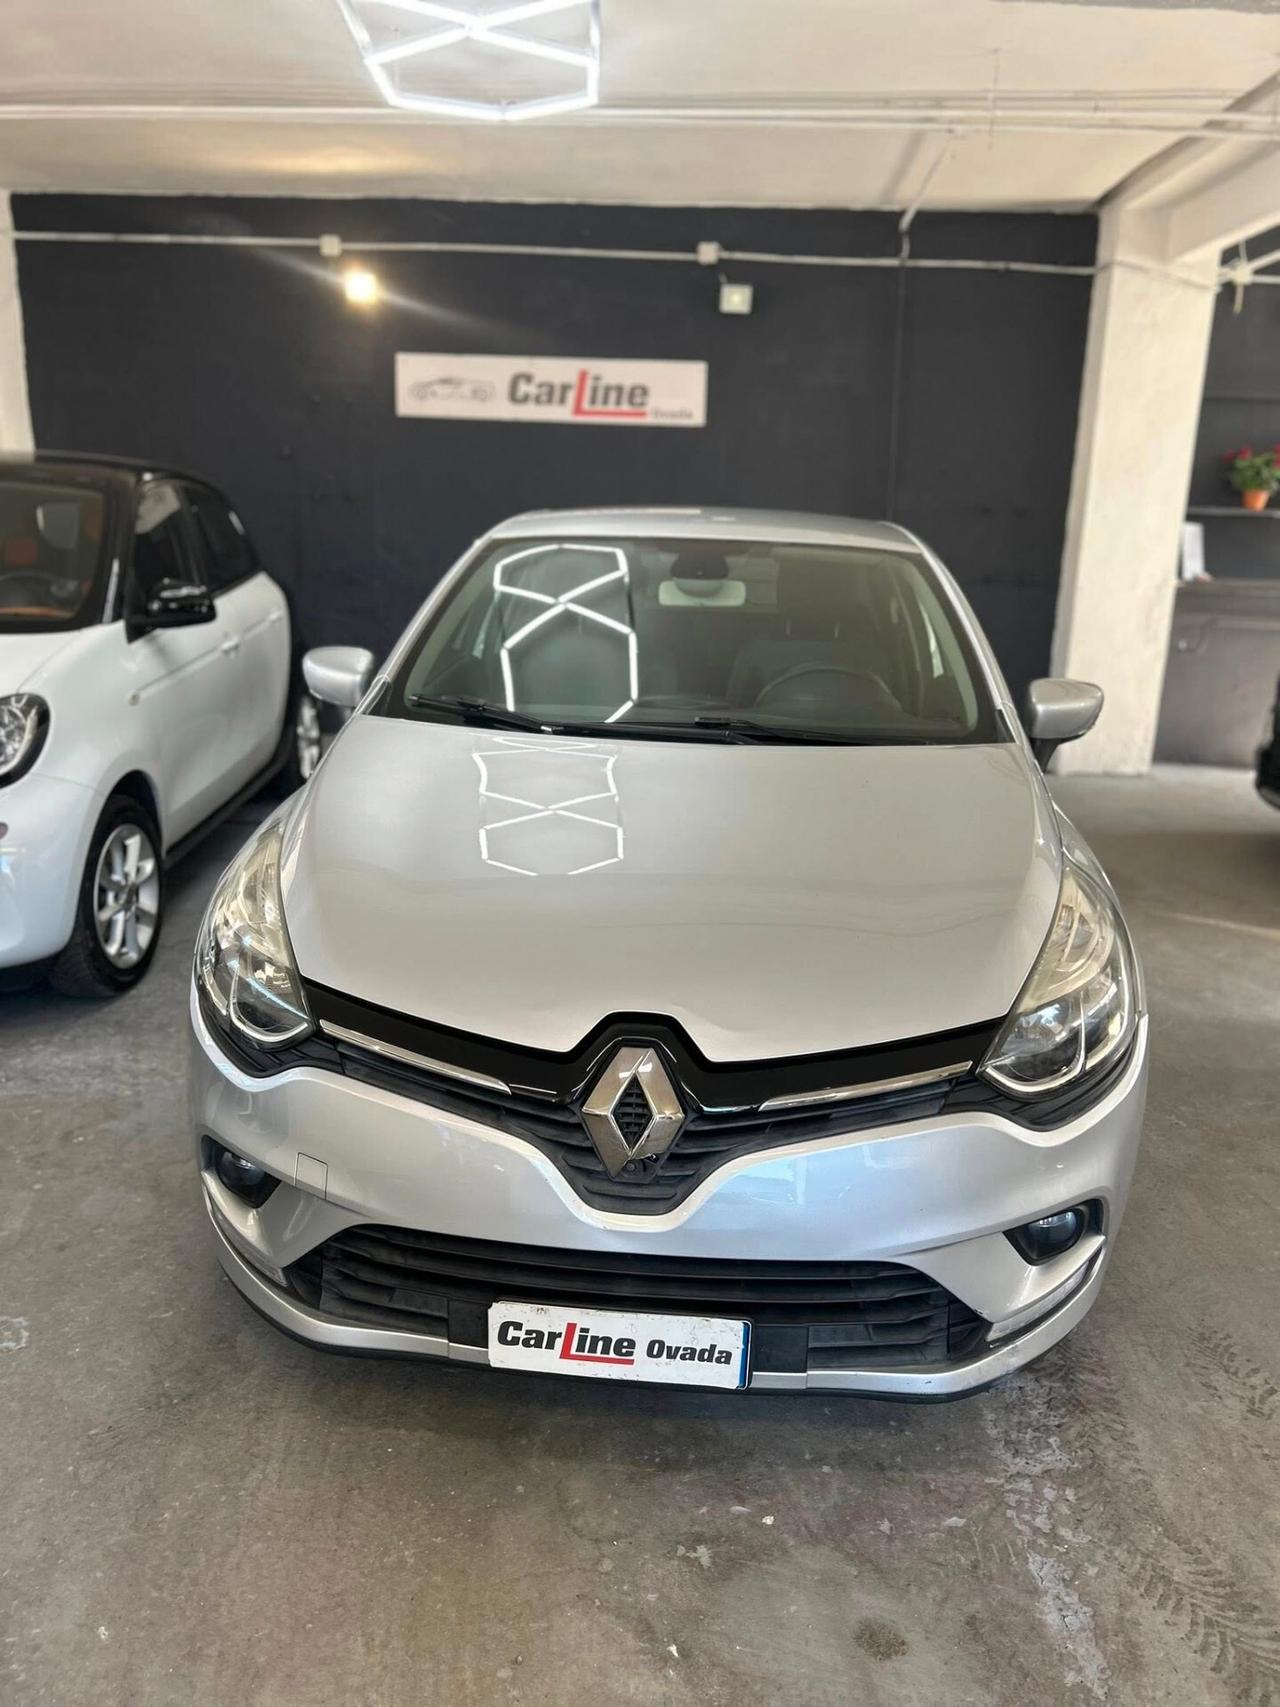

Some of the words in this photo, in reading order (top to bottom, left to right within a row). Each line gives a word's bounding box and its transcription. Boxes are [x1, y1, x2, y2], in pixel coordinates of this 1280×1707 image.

[508, 369, 649, 419] CarLine
[497, 1320, 636, 1365] CarLine
[646, 1339, 732, 1365] Ovada
